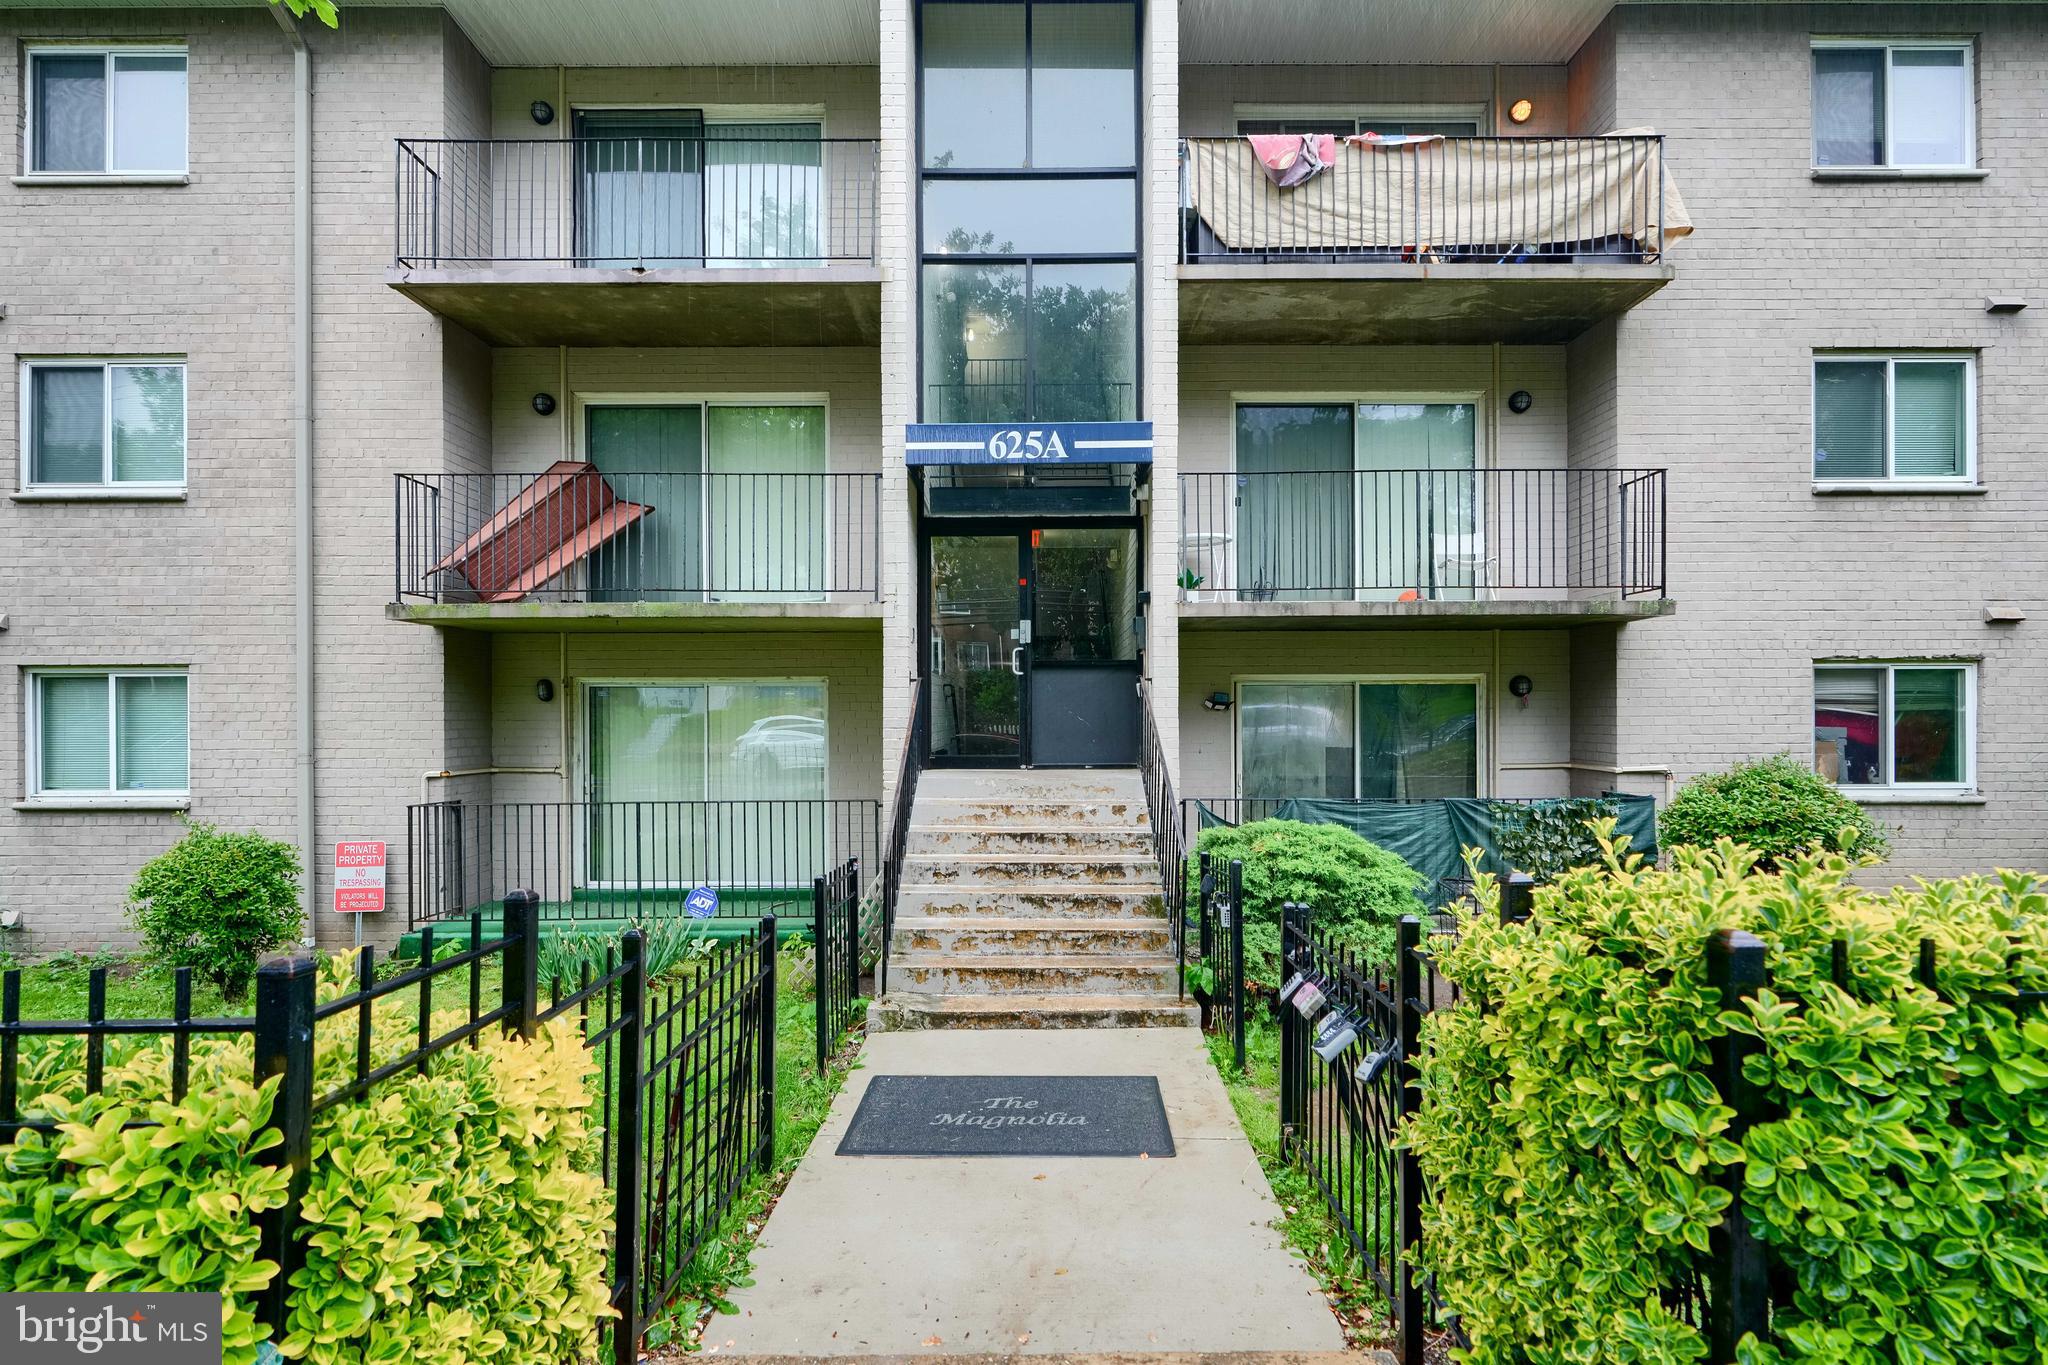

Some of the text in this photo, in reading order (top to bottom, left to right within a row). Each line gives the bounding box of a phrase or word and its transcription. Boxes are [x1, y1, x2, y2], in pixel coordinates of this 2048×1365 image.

[989, 430, 1069, 459] 625A
[344, 845, 378, 854] PRIVATE
[338, 855, 383, 865] PROPERTY
[355, 868, 366, 877] NO
[339, 878, 382, 887] TRESPASSING
[340, 892, 366, 900] VIOLATORS
[340, 900, 379, 909] BE PROSECUTED
[690, 896, 714, 910] ADT
[983, 1096, 1039, 1109] The
[929, 1111, 1089, 1130] Magnolia
